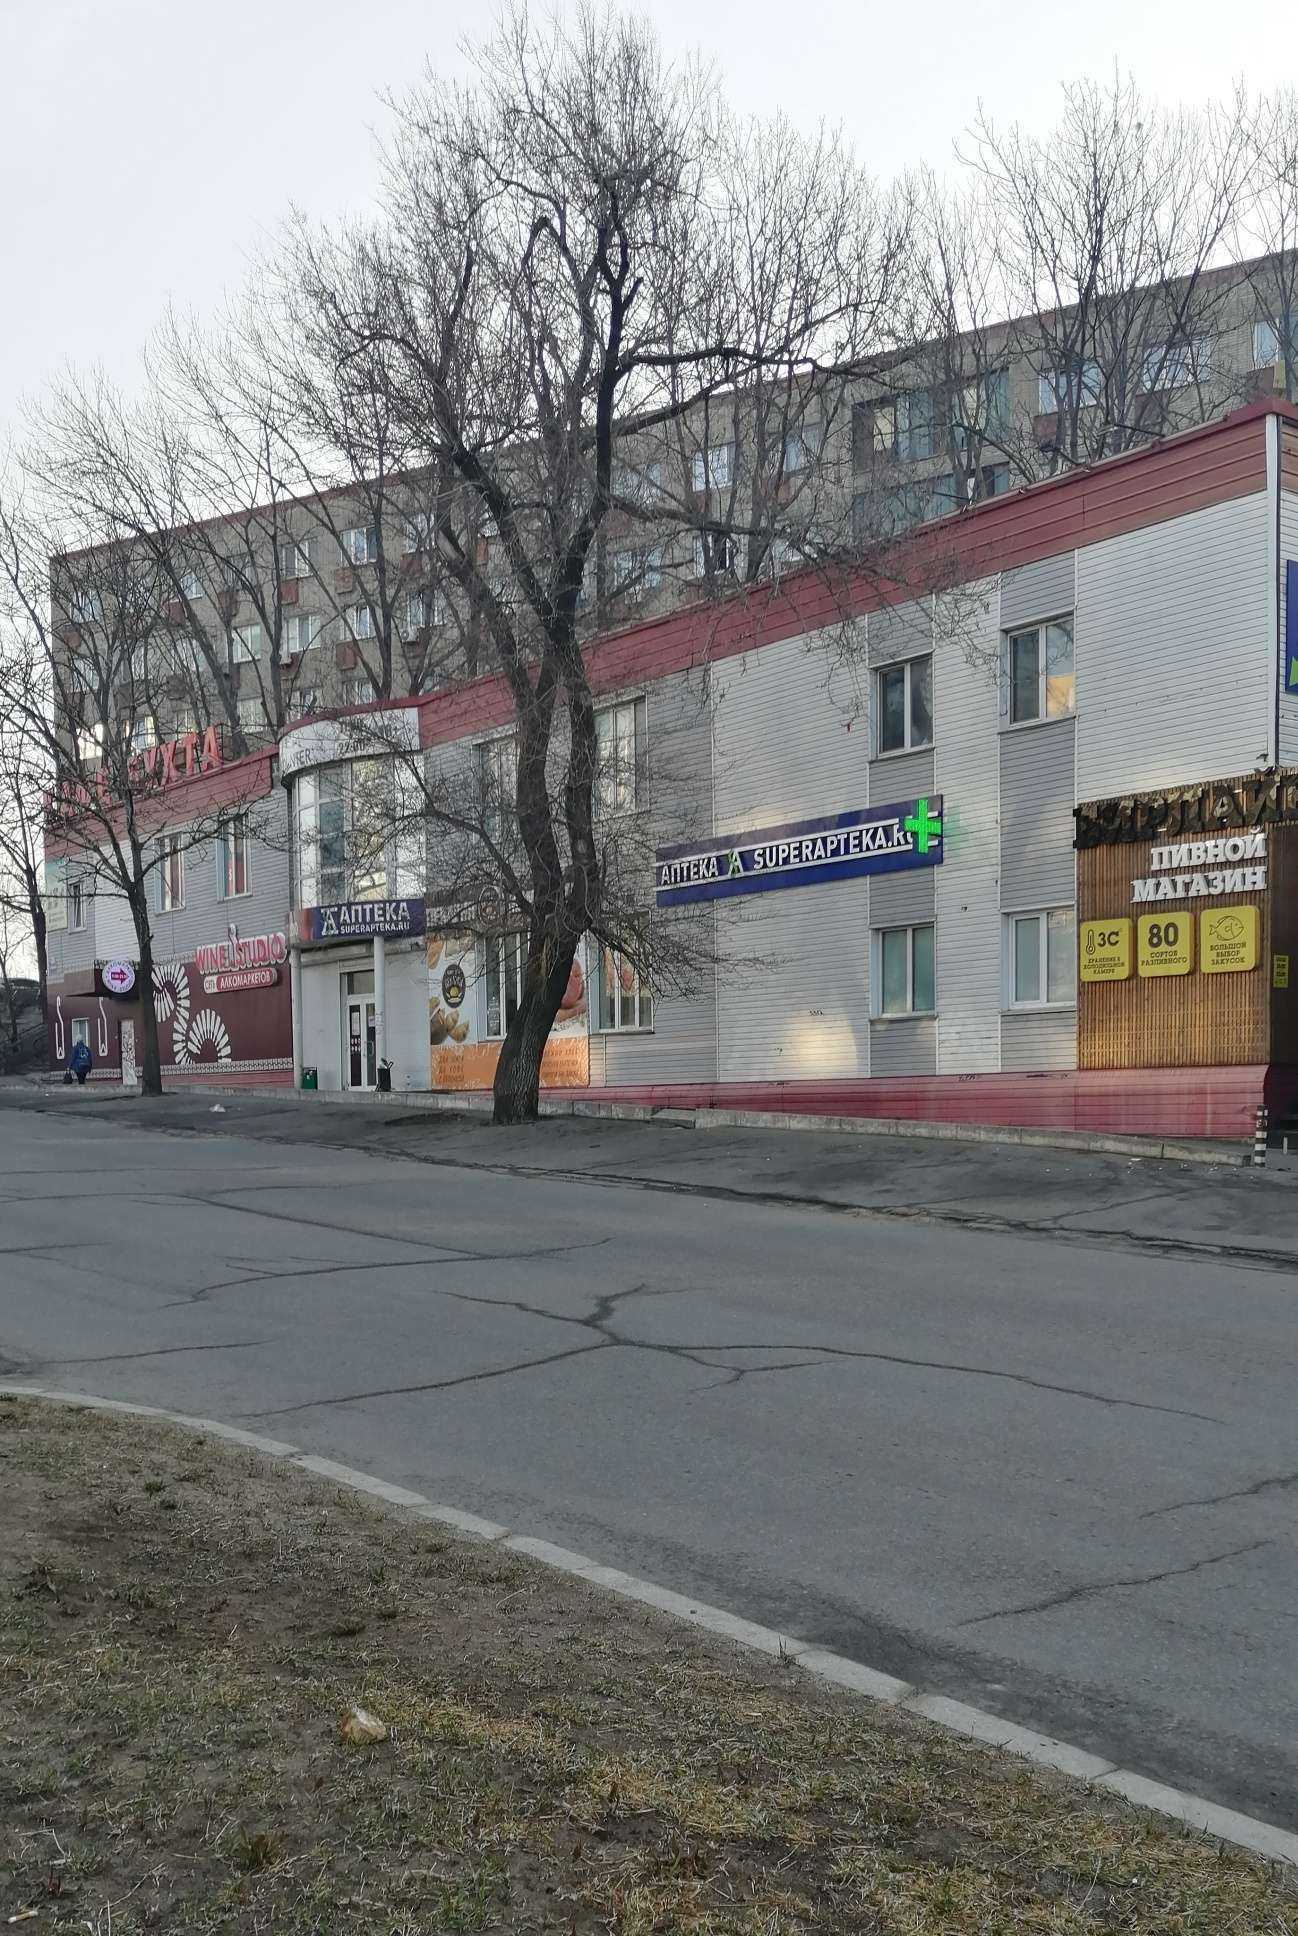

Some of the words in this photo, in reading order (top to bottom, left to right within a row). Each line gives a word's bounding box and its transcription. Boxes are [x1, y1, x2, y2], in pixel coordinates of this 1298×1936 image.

[1151, 825, 1267, 870] ПИВНОЙ
[661, 856, 719, 886] АПТЕКА
[1130, 866, 1267, 903] МАГАЗИН
[340, 901, 411, 924] АПТЕКА
[1148, 922, 1179, 948] 80
[195, 943, 228, 973] WINE
[220, 971, 271, 990] АЛКОМАРКЕТОВ
